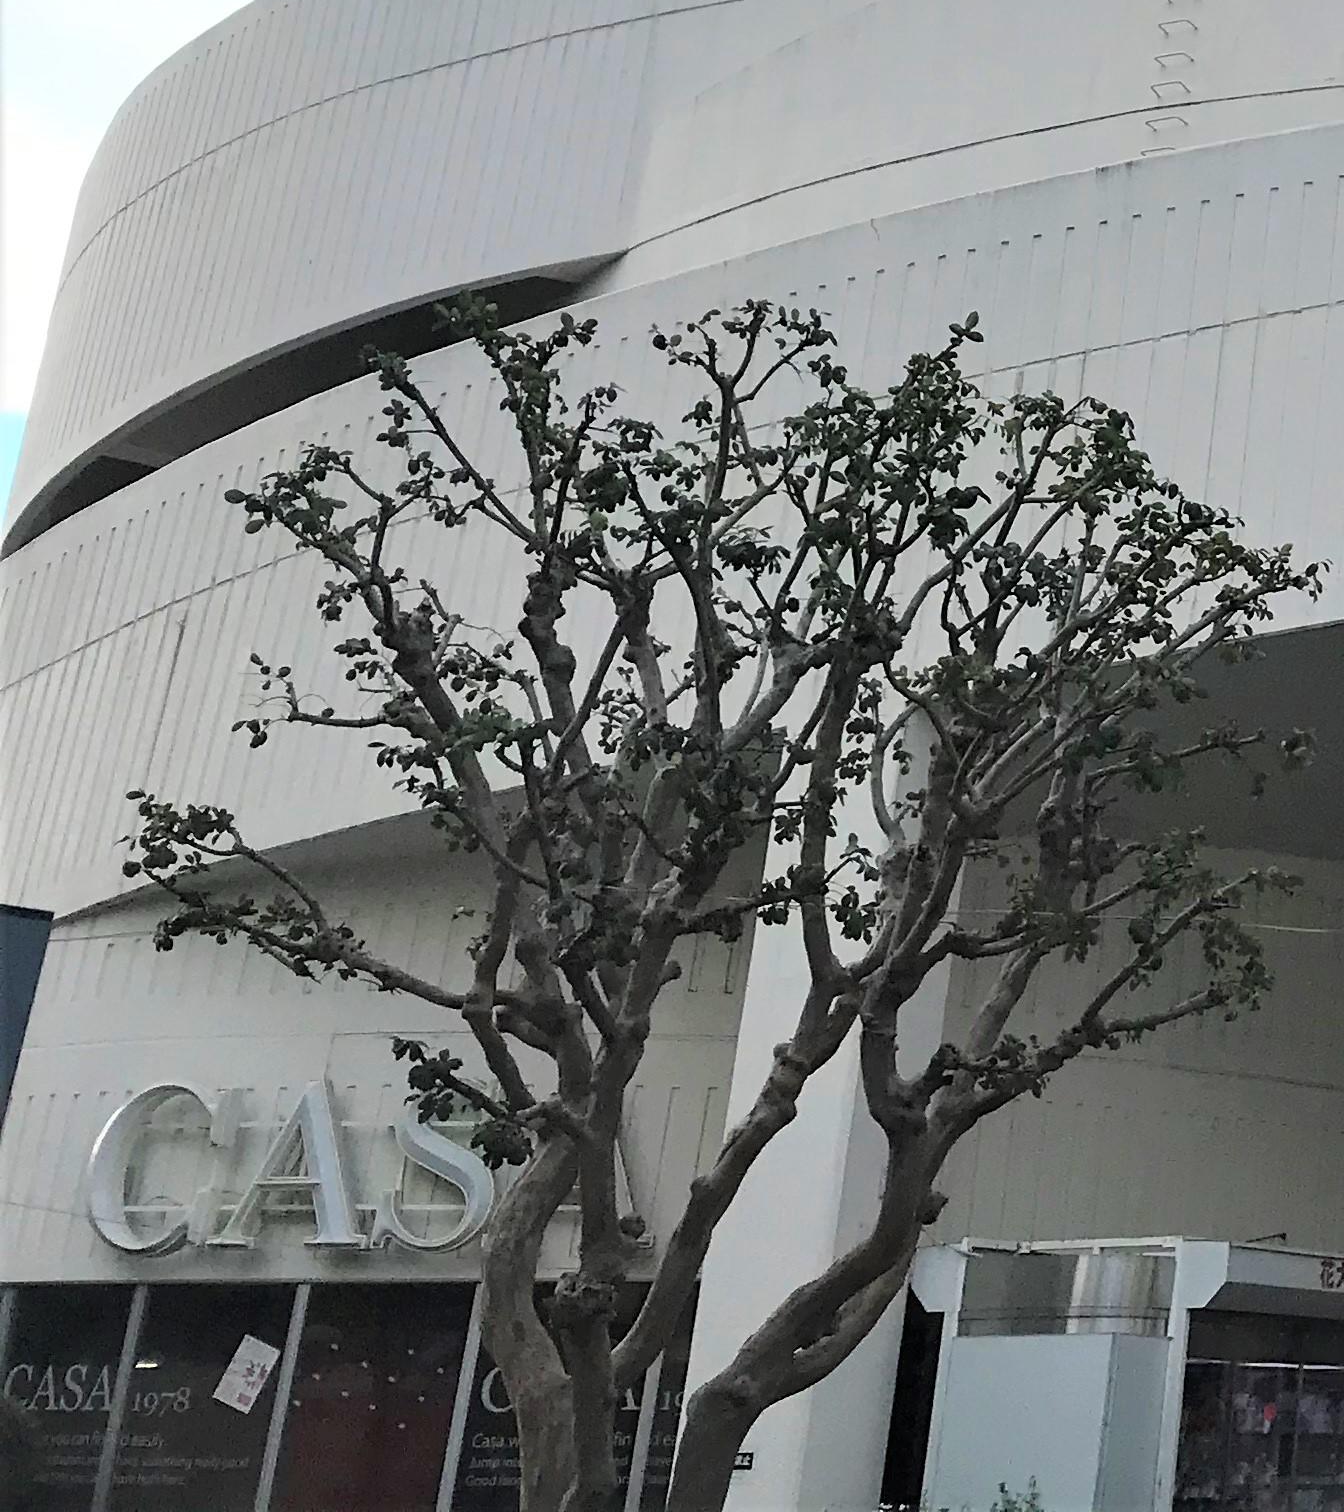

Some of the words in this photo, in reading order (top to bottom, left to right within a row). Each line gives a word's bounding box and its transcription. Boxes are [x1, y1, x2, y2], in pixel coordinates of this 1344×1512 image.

[88, 1082, 655, 1256] CAS
[4, 1364, 112, 1412] CASA
[132, 1387, 191, 1416] 1978
